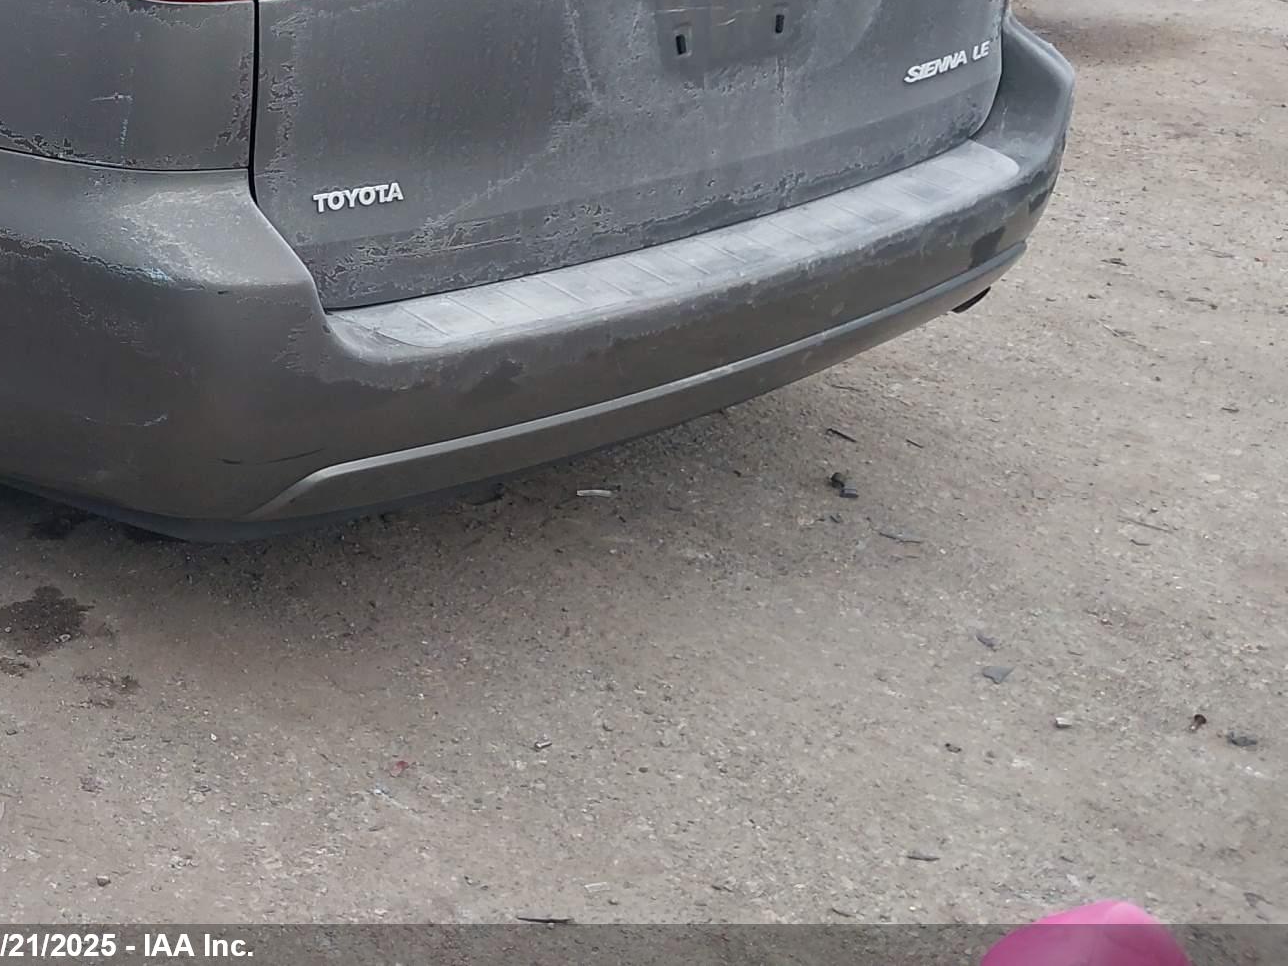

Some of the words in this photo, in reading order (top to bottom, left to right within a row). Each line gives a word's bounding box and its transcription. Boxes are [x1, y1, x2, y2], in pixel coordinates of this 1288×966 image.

[903, 50, 968, 83] SIENNA
[972, 40, 990, 61] LE
[313, 182, 404, 213] TOYOTA
